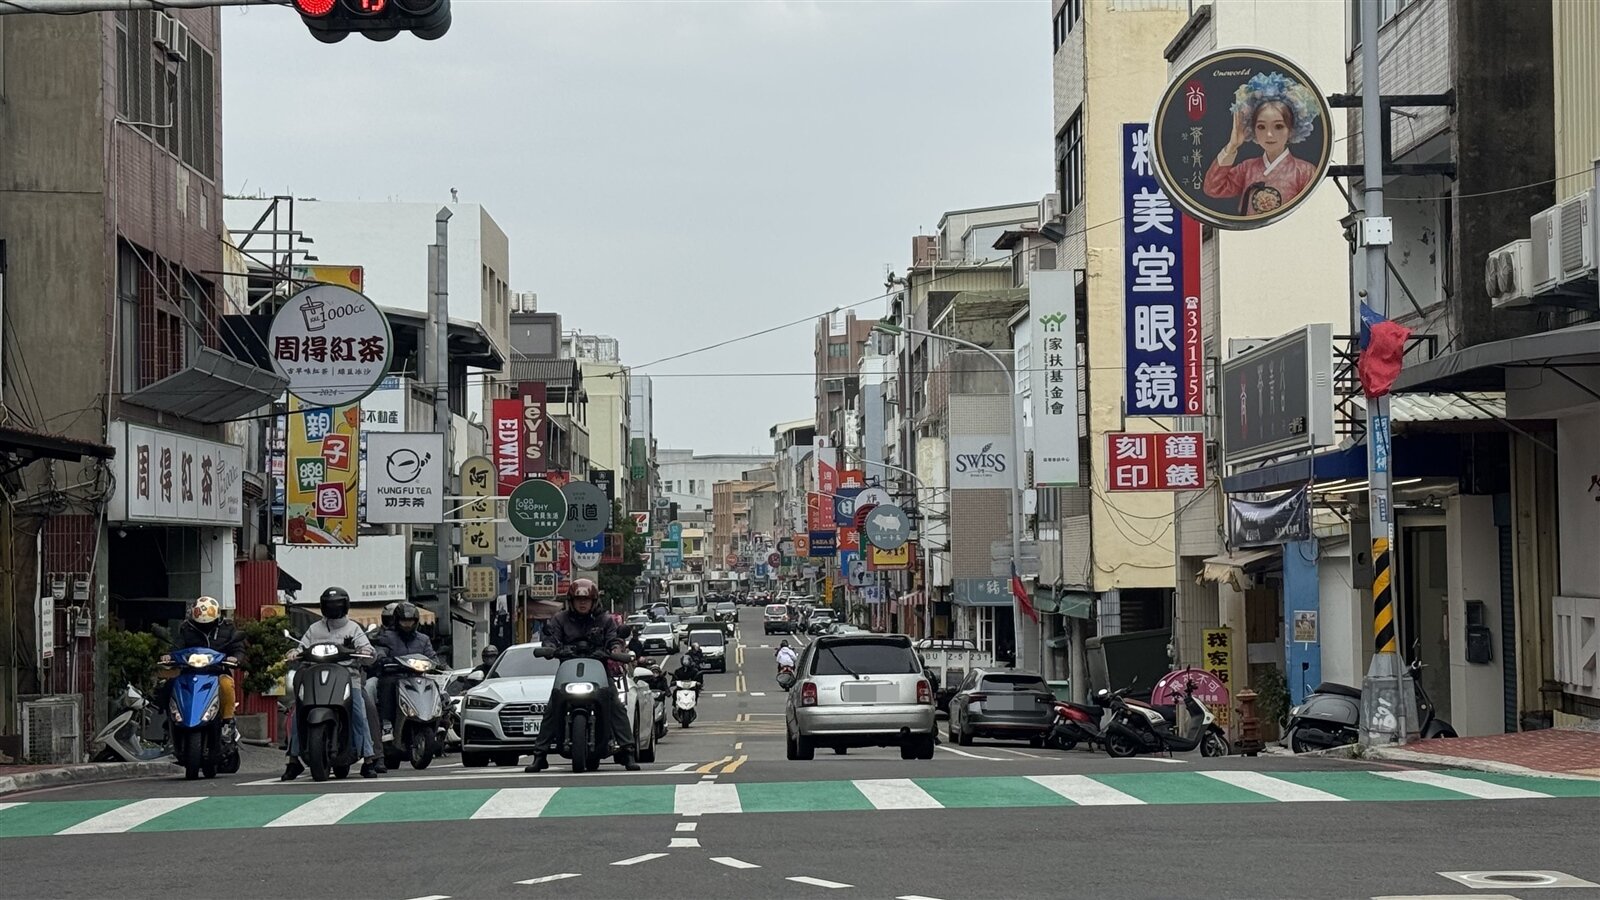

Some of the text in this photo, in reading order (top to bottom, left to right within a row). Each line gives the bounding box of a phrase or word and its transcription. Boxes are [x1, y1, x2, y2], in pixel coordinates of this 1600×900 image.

[1213, 68, 1251, 77] Oneworld
[320, 304, 366, 322] 1000cc
[275, 336, 384, 363] 周得紅茶
[1187, 311, 1199, 411] 321156
[1048, 337, 1064, 415] 家扶基金會
[498, 418, 519, 476] EDWIN
[956, 453, 1006, 473] SWISS
[137, 444, 212, 507] 周得紅茶
[415, 486, 432, 495] TEA
[384, 497, 425, 508] 功夫茶
